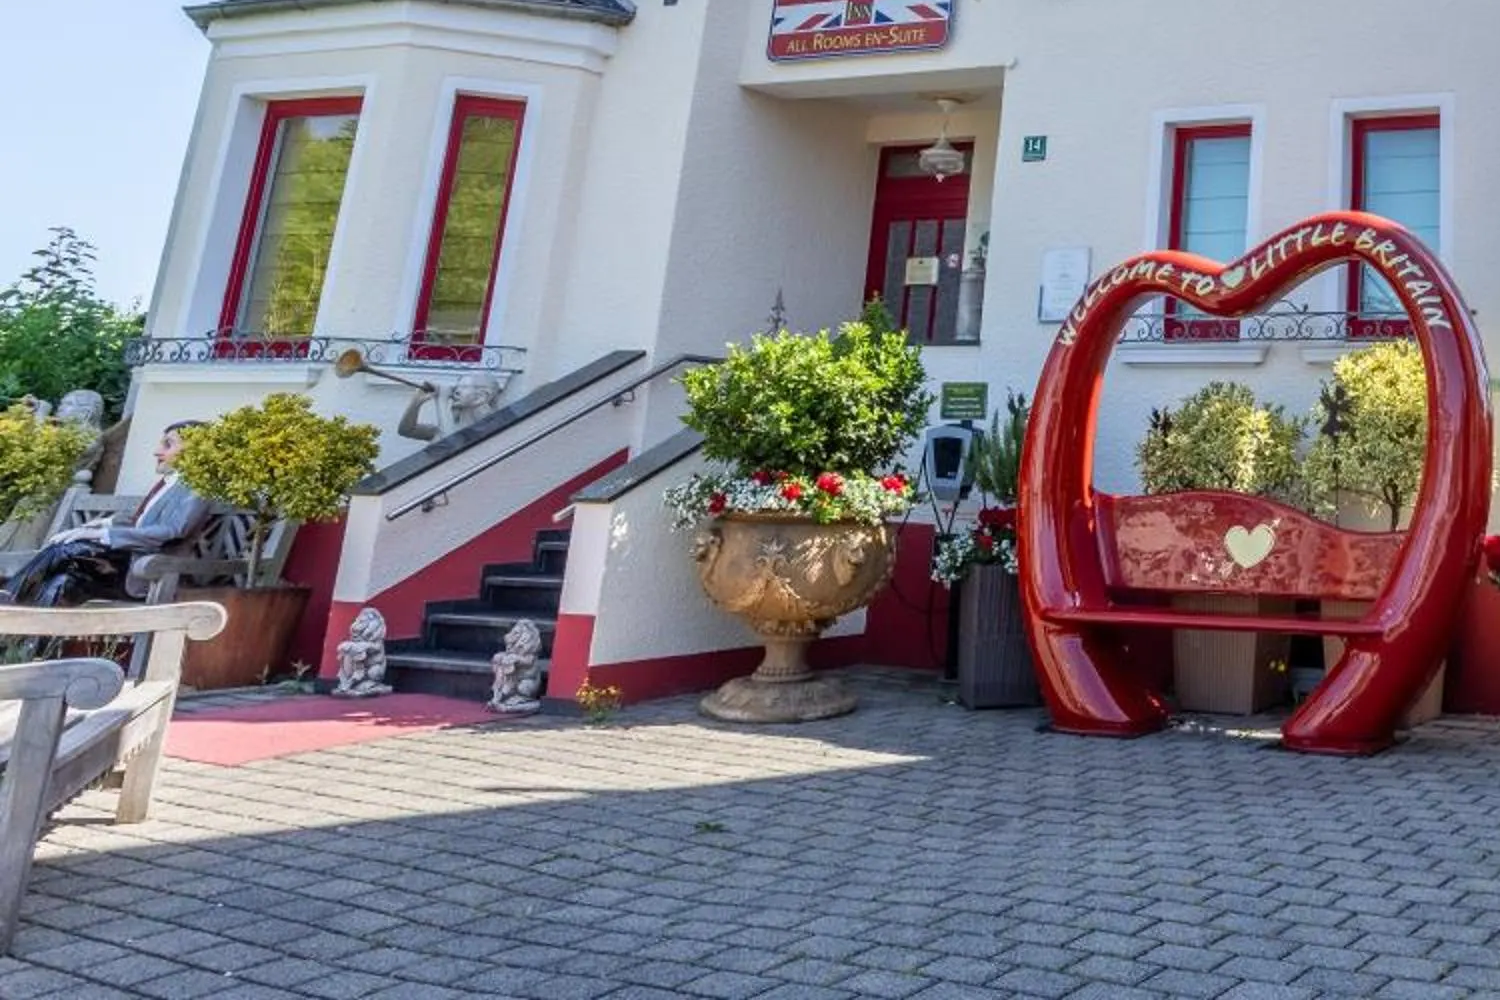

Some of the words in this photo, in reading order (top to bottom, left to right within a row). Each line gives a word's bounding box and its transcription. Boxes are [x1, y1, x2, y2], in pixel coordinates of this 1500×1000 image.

[846, 1, 872, 21] INN
[786, 38, 808, 53] ALL
[812, 33, 862, 50] ROOMS
[865, 25, 926, 47] EN-SUITE
[1028, 139, 1041, 151] 14
[1058, 261, 1173, 346] WELCOME
[1180, 270, 1213, 296] TO
[1249, 221, 1346, 280] LITTLE
[1354, 224, 1452, 329] BRITAIN
